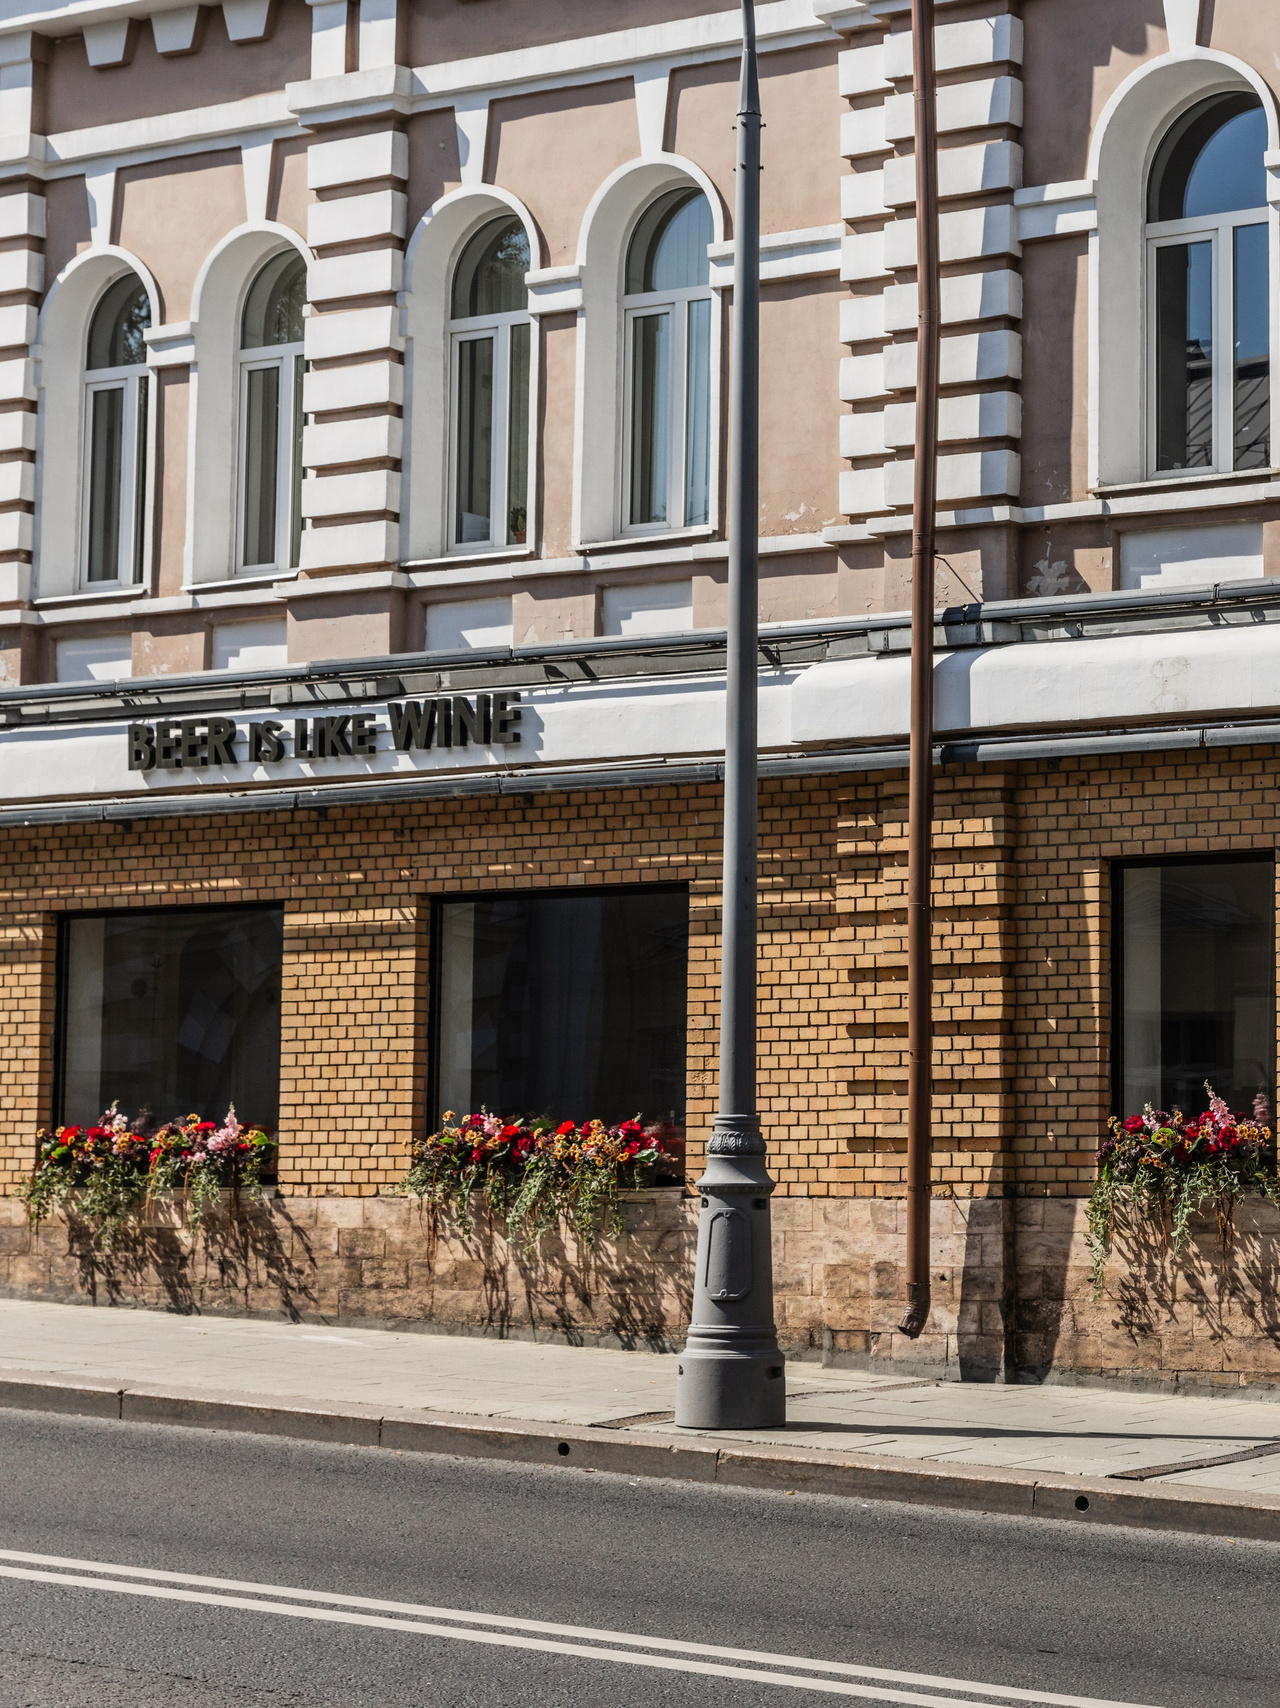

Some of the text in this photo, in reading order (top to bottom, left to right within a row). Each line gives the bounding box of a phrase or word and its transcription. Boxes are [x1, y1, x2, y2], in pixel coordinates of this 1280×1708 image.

[128, 691, 522, 771] BEER IS LIKE WINE
